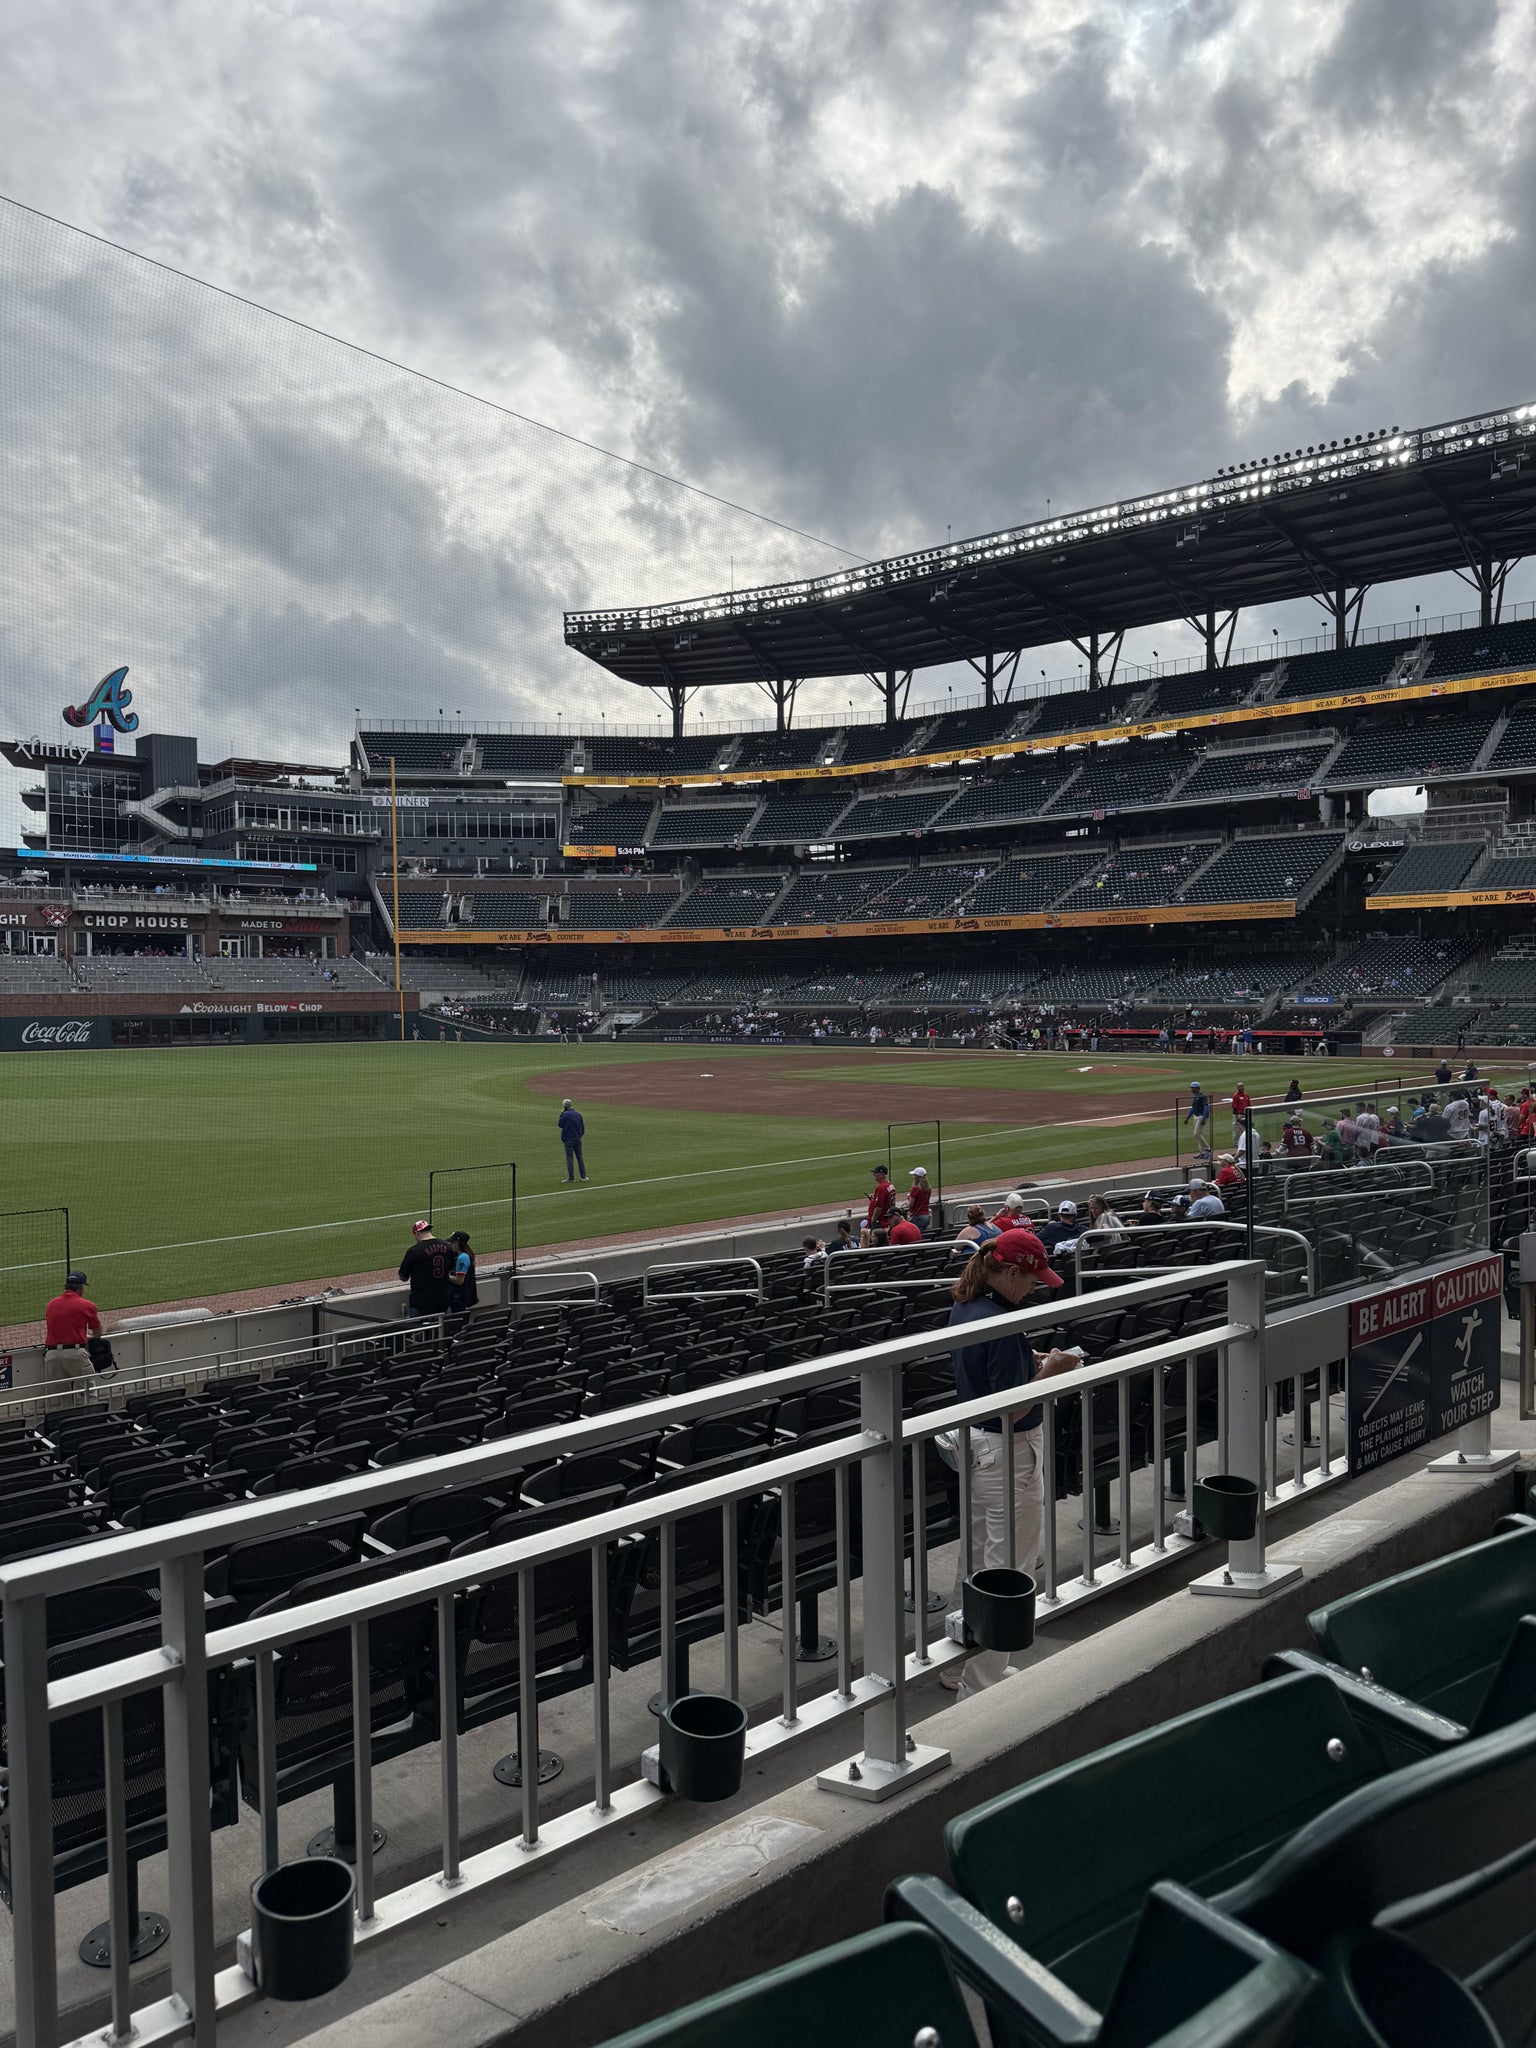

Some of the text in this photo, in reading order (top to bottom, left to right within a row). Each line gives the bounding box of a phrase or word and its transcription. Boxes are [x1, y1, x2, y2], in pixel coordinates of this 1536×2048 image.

[1371, 692, 1398, 700] COUNTRY
[15, 735, 90, 765] xfinity
[617, 847, 645, 855] 5:34 PM
[1364, 840, 1404, 849] LEXUS
[84, 915, 189, 929] CHOP HOUSE
[241, 920, 268, 929] MADE
[271, 921, 283, 929] TO
[984, 920, 1012, 928] COUNTRY
[1097, 915, 1124, 923] ATLANTA
[193, 1002, 252, 1013] Coors LIGHT
[257, 1003, 289, 1013] BELOW
[299, 1003, 323, 1012] CHOP
[22, 1021, 94, 1044] Coca-Cola
[1293, 1135, 1306, 1146] 19
[1436, 1263, 1500, 1309] CAUTION
[1359, 1287, 1427, 1336] BE ALERT
[1450, 1373, 1485, 1404] WATCH
[1440, 1390, 1494, 1430] YOUR STEP
[1358, 1399, 1426, 1439] OBJECTS MAY LEAVE
[1360, 1415, 1424, 1453] THE PLAYING FIELD
[1356, 1426, 1427, 1470] & MAY CAUSE INJURY
